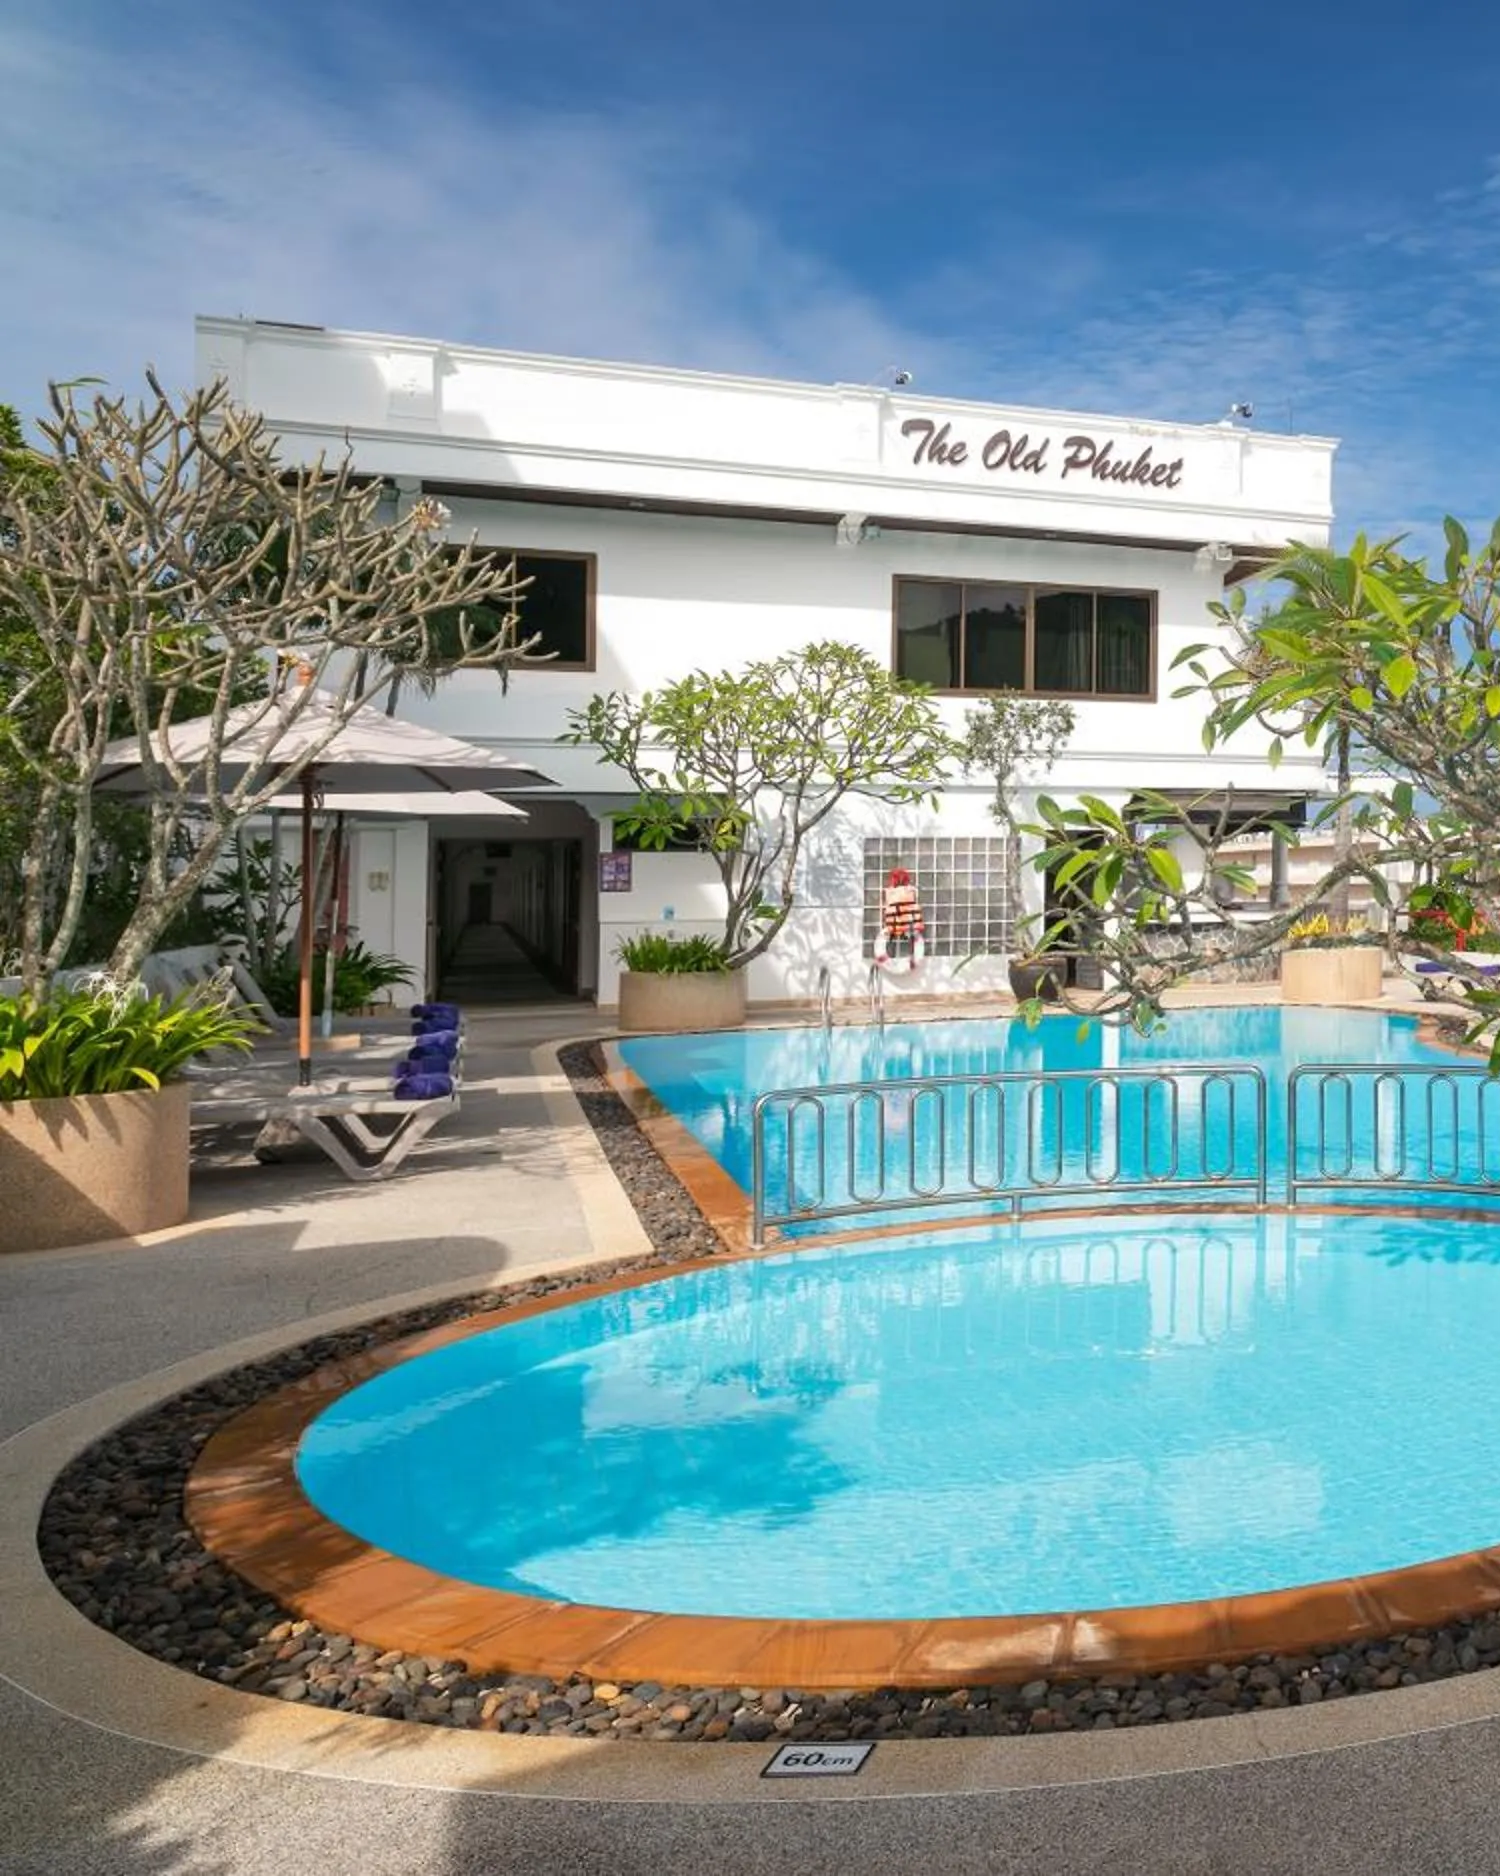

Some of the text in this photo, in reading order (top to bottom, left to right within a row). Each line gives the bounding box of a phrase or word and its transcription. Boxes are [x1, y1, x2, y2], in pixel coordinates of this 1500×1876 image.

[901, 418, 1184, 489] The Old Phuket
[783, 1752, 853, 1767] 60cm
